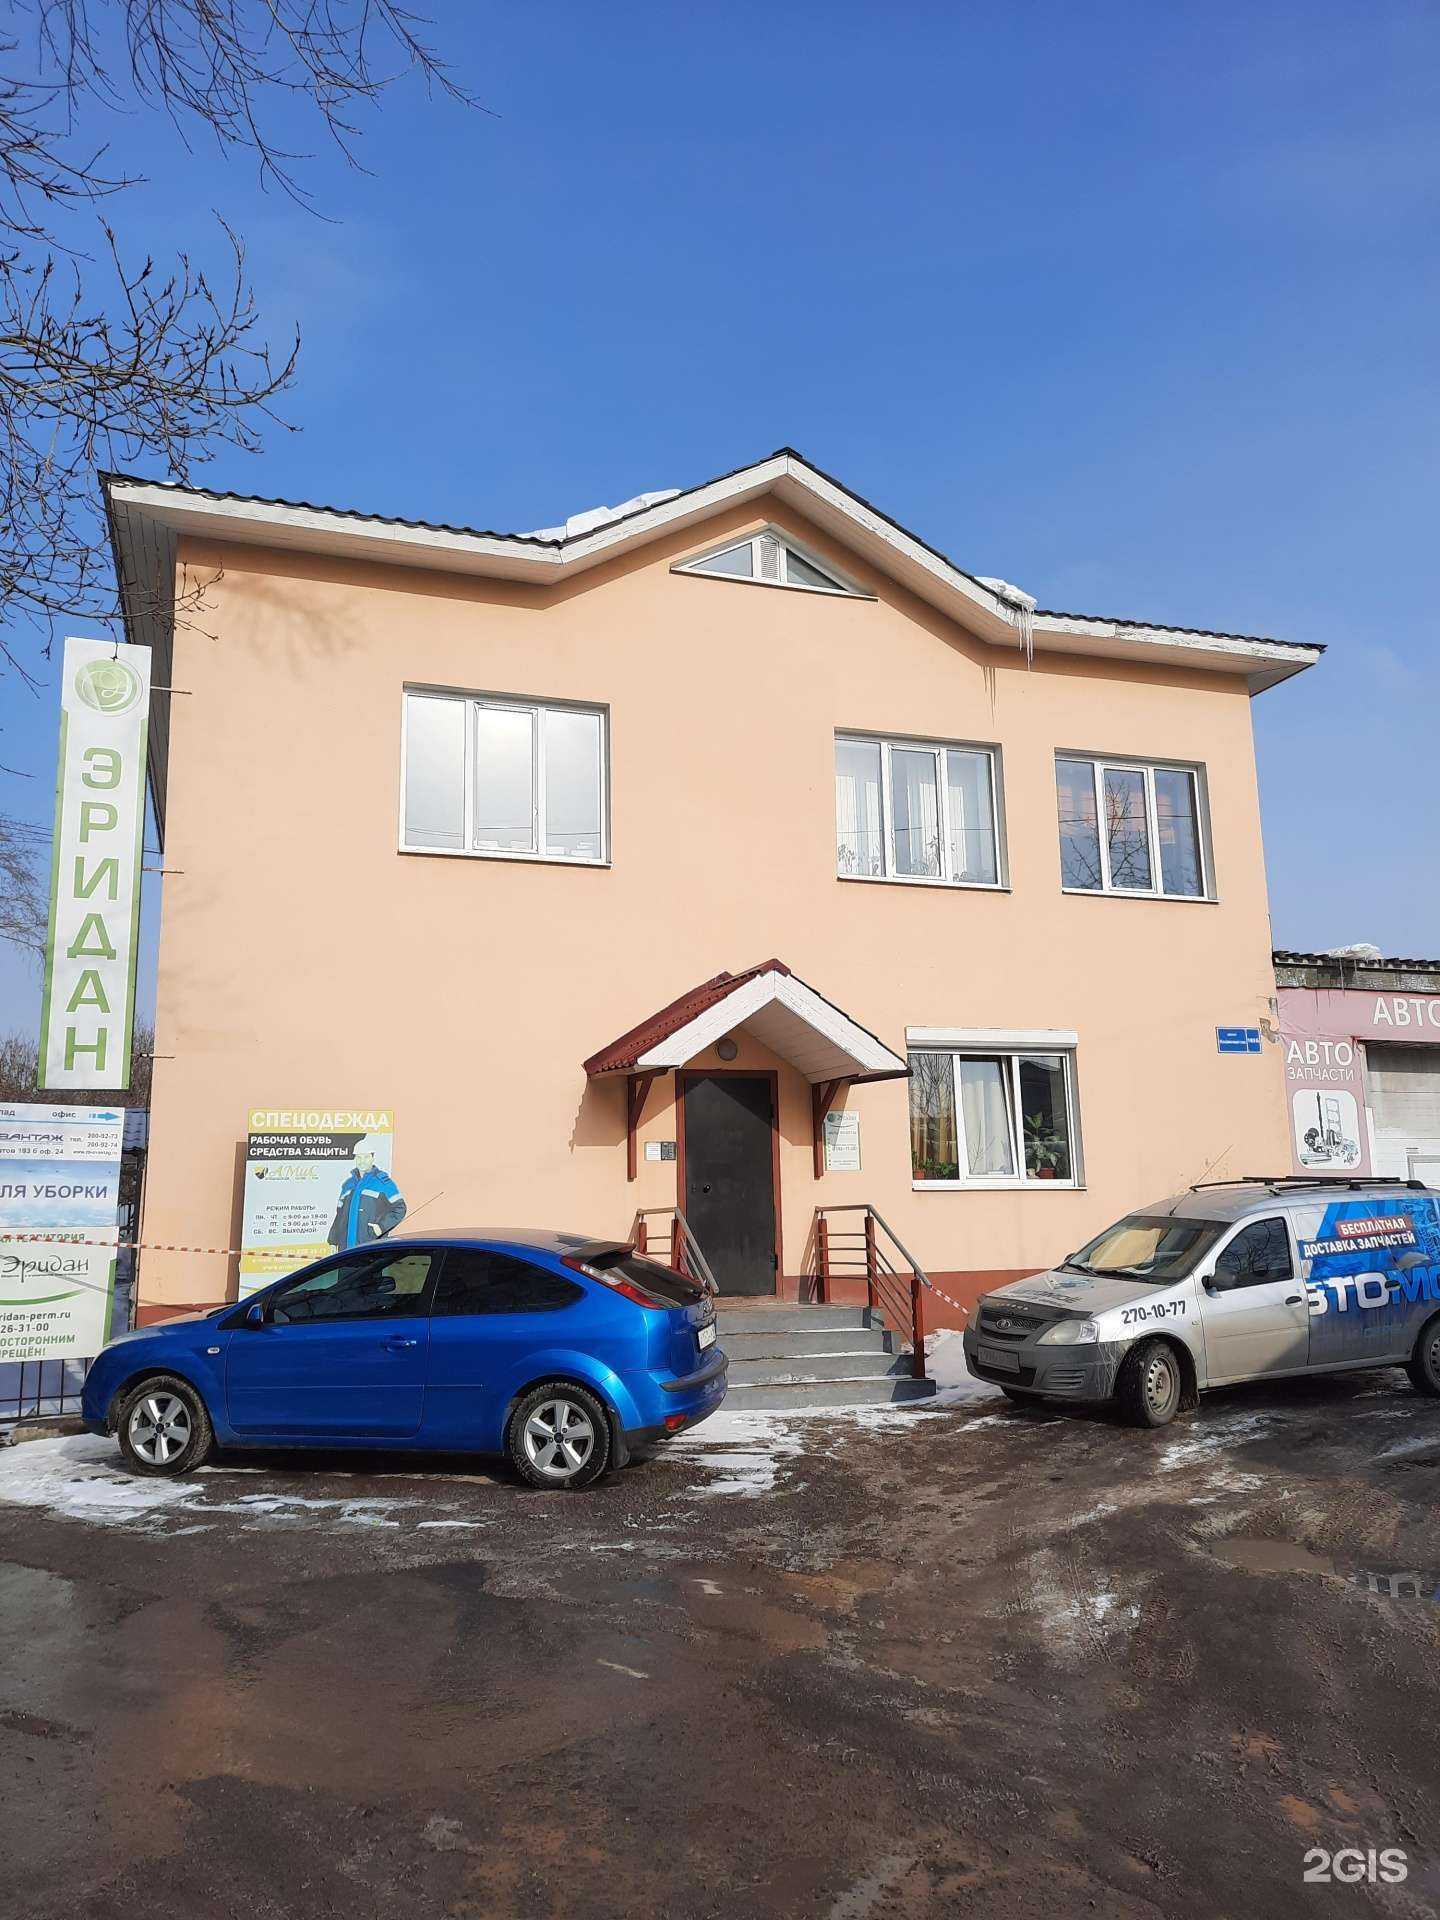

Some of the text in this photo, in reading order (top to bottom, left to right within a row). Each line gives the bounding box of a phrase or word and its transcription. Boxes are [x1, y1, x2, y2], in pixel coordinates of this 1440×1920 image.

[64, 747, 122, 1070] ЭРИДАН
[1287, 1040, 1353, 1066] АВТО
[1287, 1066, 1354, 1081] ЗАПЧАСТИ
[52, 1111, 76, 1119] офис
[251, 1112, 389, 1130] СПЕЦОДЕЖДА
[250, 1136, 332, 1144] РАБОЧАЯ ОБУВЬ
[249, 1147, 349, 1157] СРЕДСТВА ЗАЩИТЫ
[33, 1185, 107, 1198] УБОРКИ
[1340, 1218, 1407, 1236] БЕСПЛАТНАЯ
[1303, 1231, 1416, 1258] ДОСТАВКА ЗАПЧАСТЕЙ
[2, 1255, 89, 1283] Эридан
[1121, 1300, 1186, 1324] 270-10-77
[0, 1322, 49, 1333] 26-31-00
[0, 1335, 75, 1347] ОСТОРОННИМ
[0, 1346, 46, 1359] РЕЩЁН!
